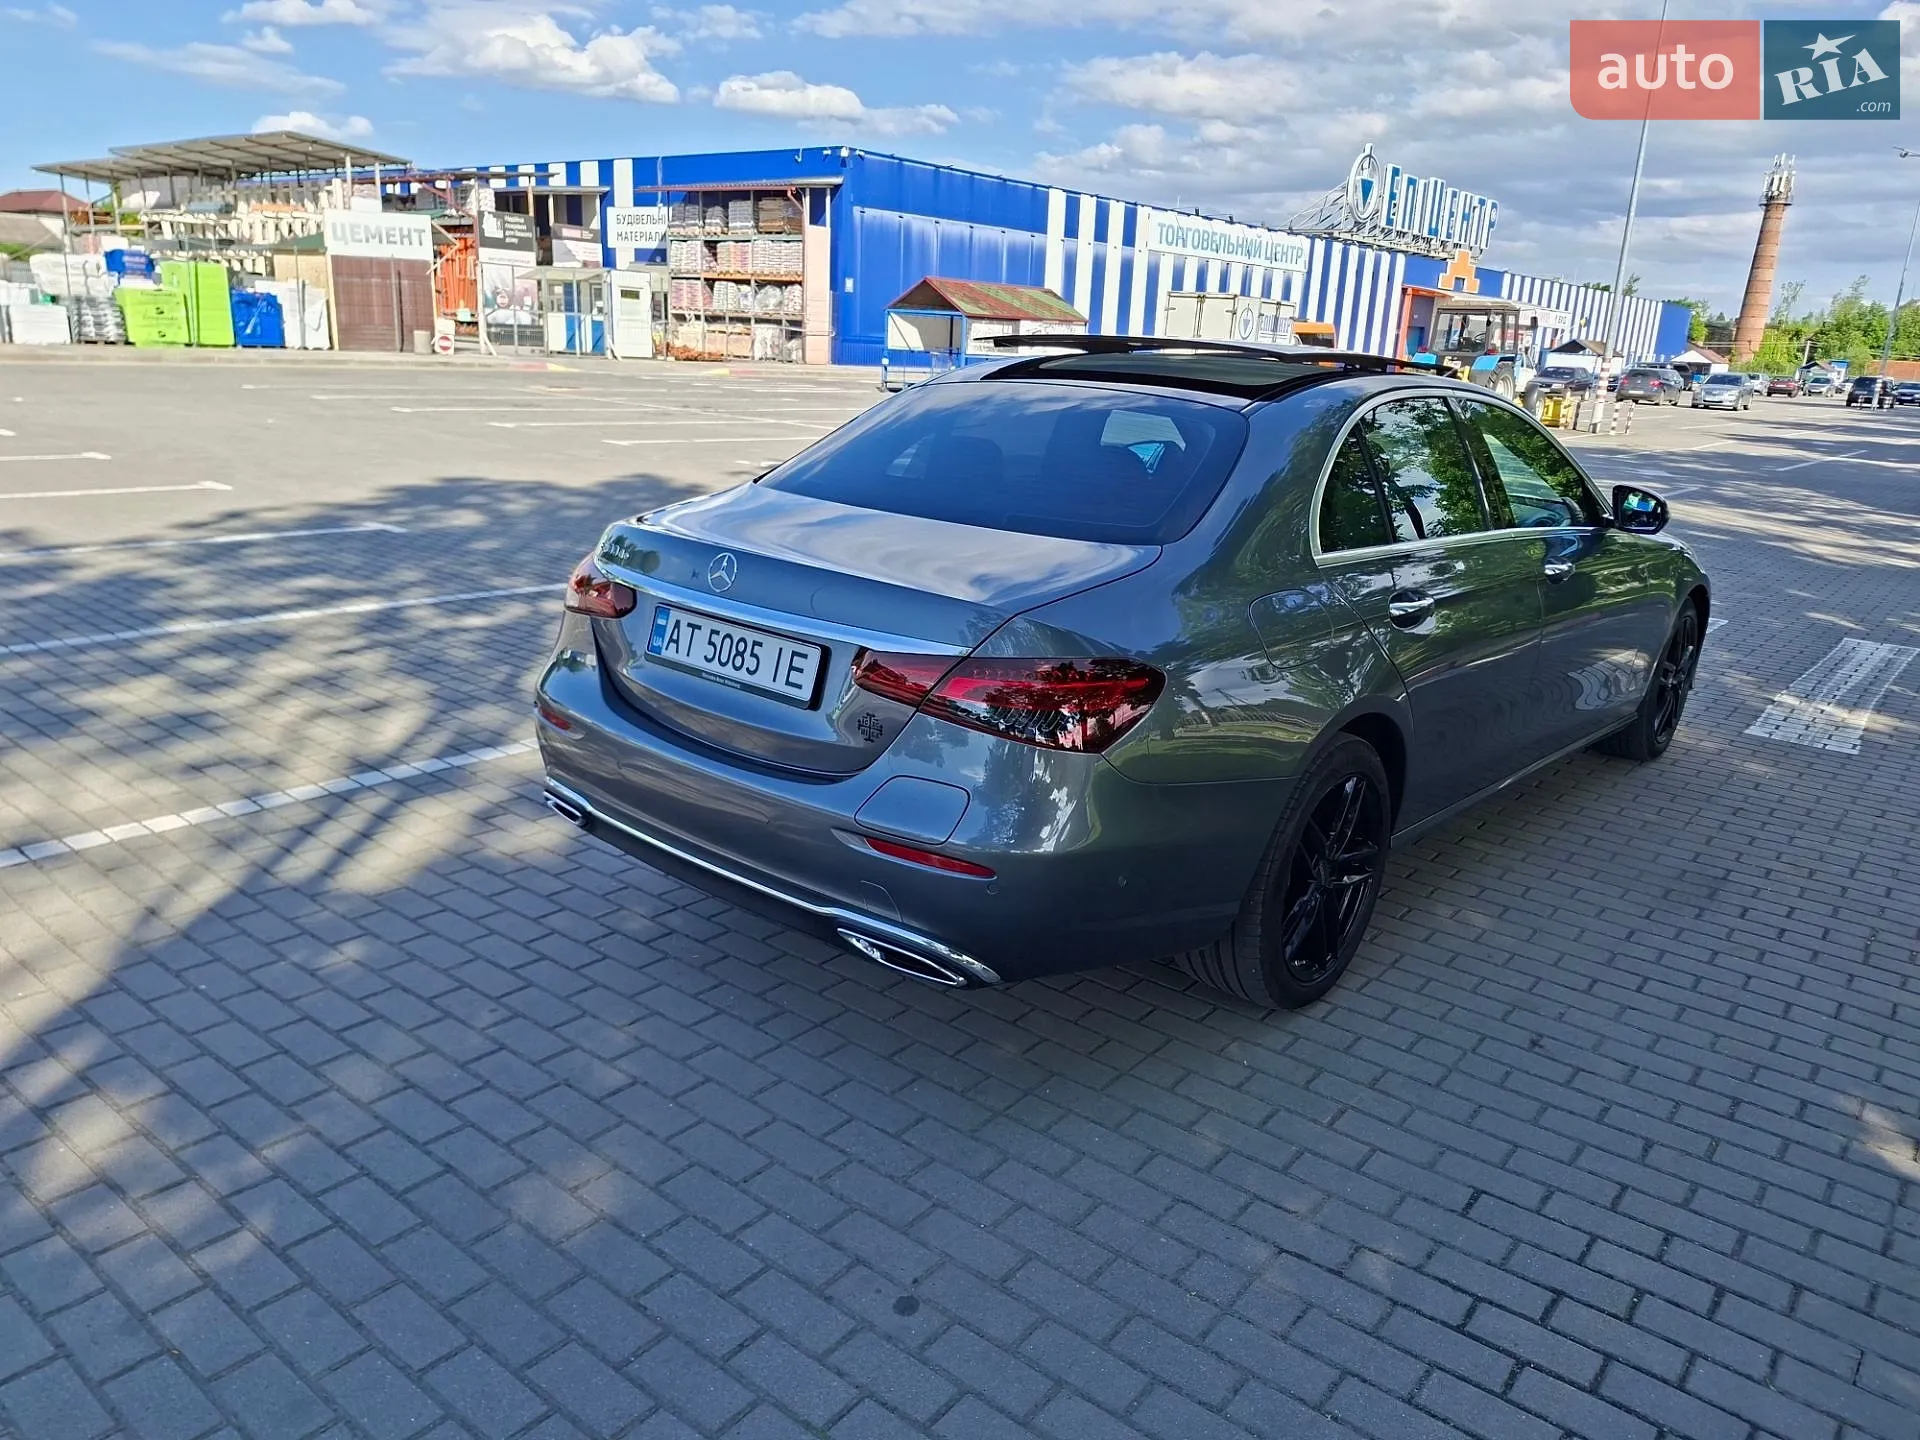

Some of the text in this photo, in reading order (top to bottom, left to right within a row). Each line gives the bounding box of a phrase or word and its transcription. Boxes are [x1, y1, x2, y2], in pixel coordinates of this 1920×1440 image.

[332, 223, 426, 246] ЦЕМЕНТ
[1157, 222, 1305, 265] ТОРГОВЕЛЬНИЙ ЦЕНТР
[665, 619, 702, 657] AT
[704, 628, 763, 676] 5085
